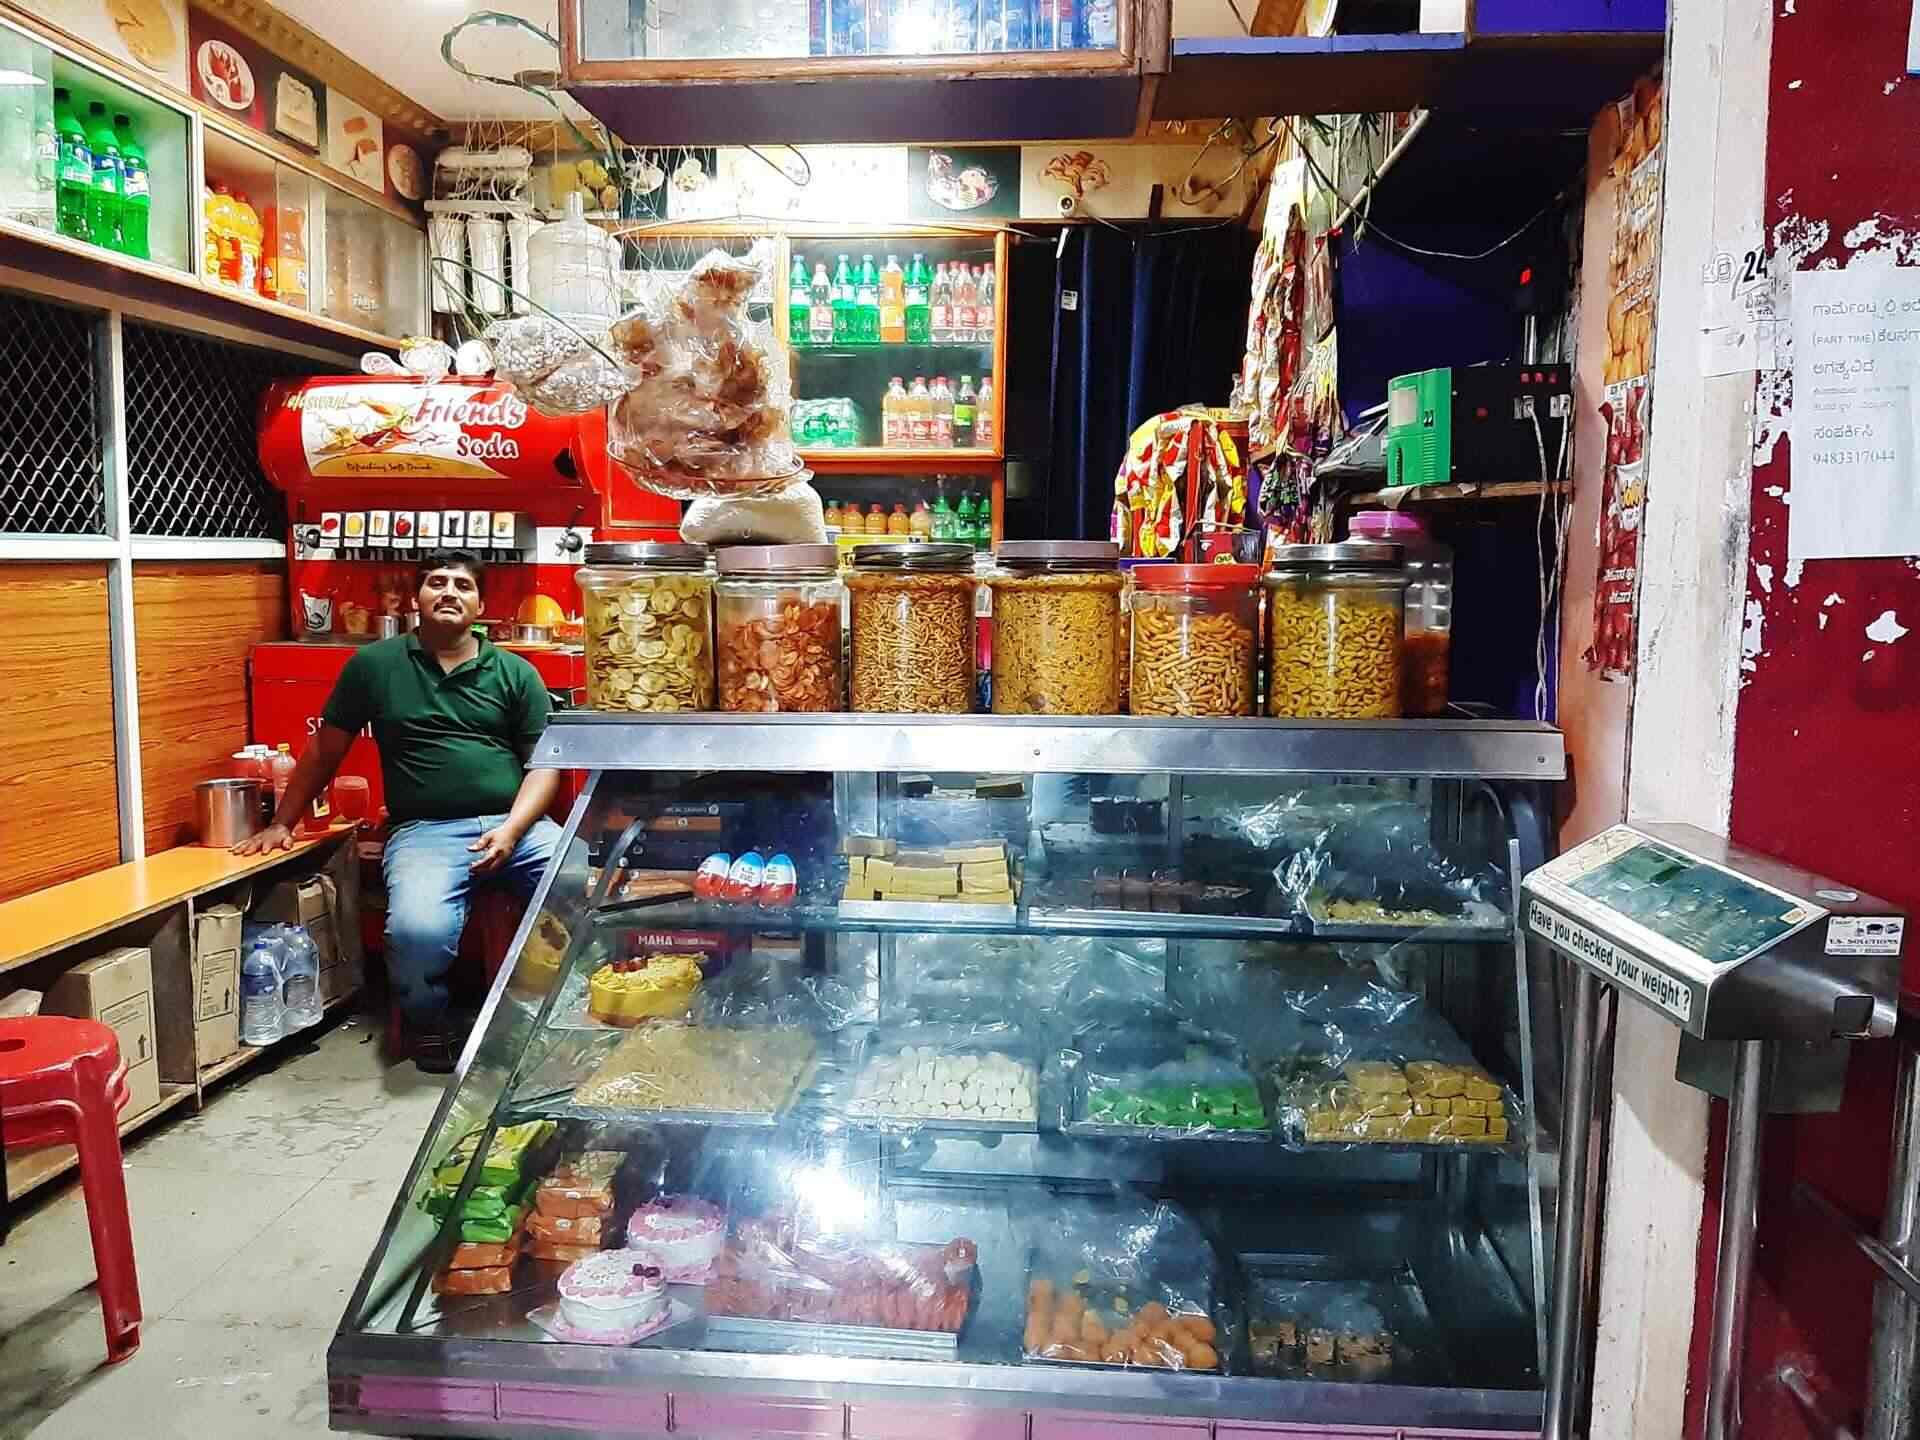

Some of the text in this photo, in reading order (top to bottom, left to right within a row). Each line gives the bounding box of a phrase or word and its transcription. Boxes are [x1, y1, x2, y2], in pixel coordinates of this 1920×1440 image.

[456, 432, 519, 458] Soda
[1530, 903, 1690, 1012] Have you checked your weight ?
